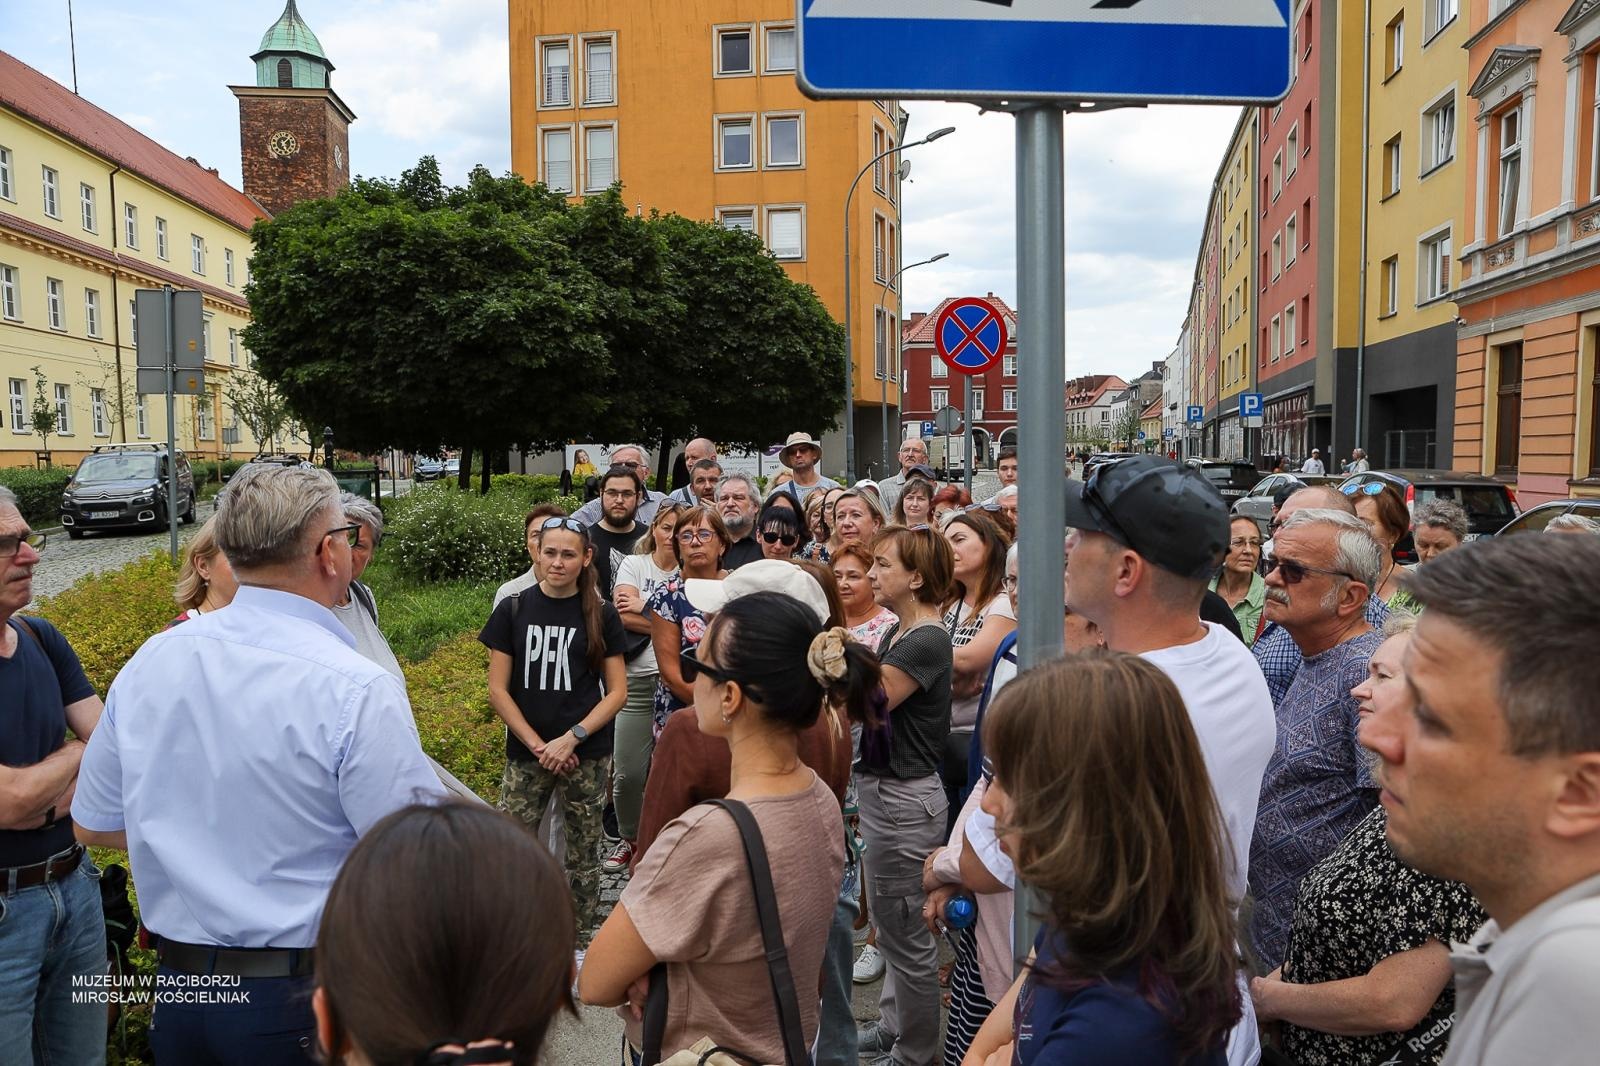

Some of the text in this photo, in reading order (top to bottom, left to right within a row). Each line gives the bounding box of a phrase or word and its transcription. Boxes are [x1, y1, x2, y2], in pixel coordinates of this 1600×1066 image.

[1191, 408, 1200, 420] P
[1245, 396, 1258, 414] P
[924, 422, 932, 432] P
[524, 624, 577, 692] PFK
[1407, 1012, 1457, 1053] Reebo
